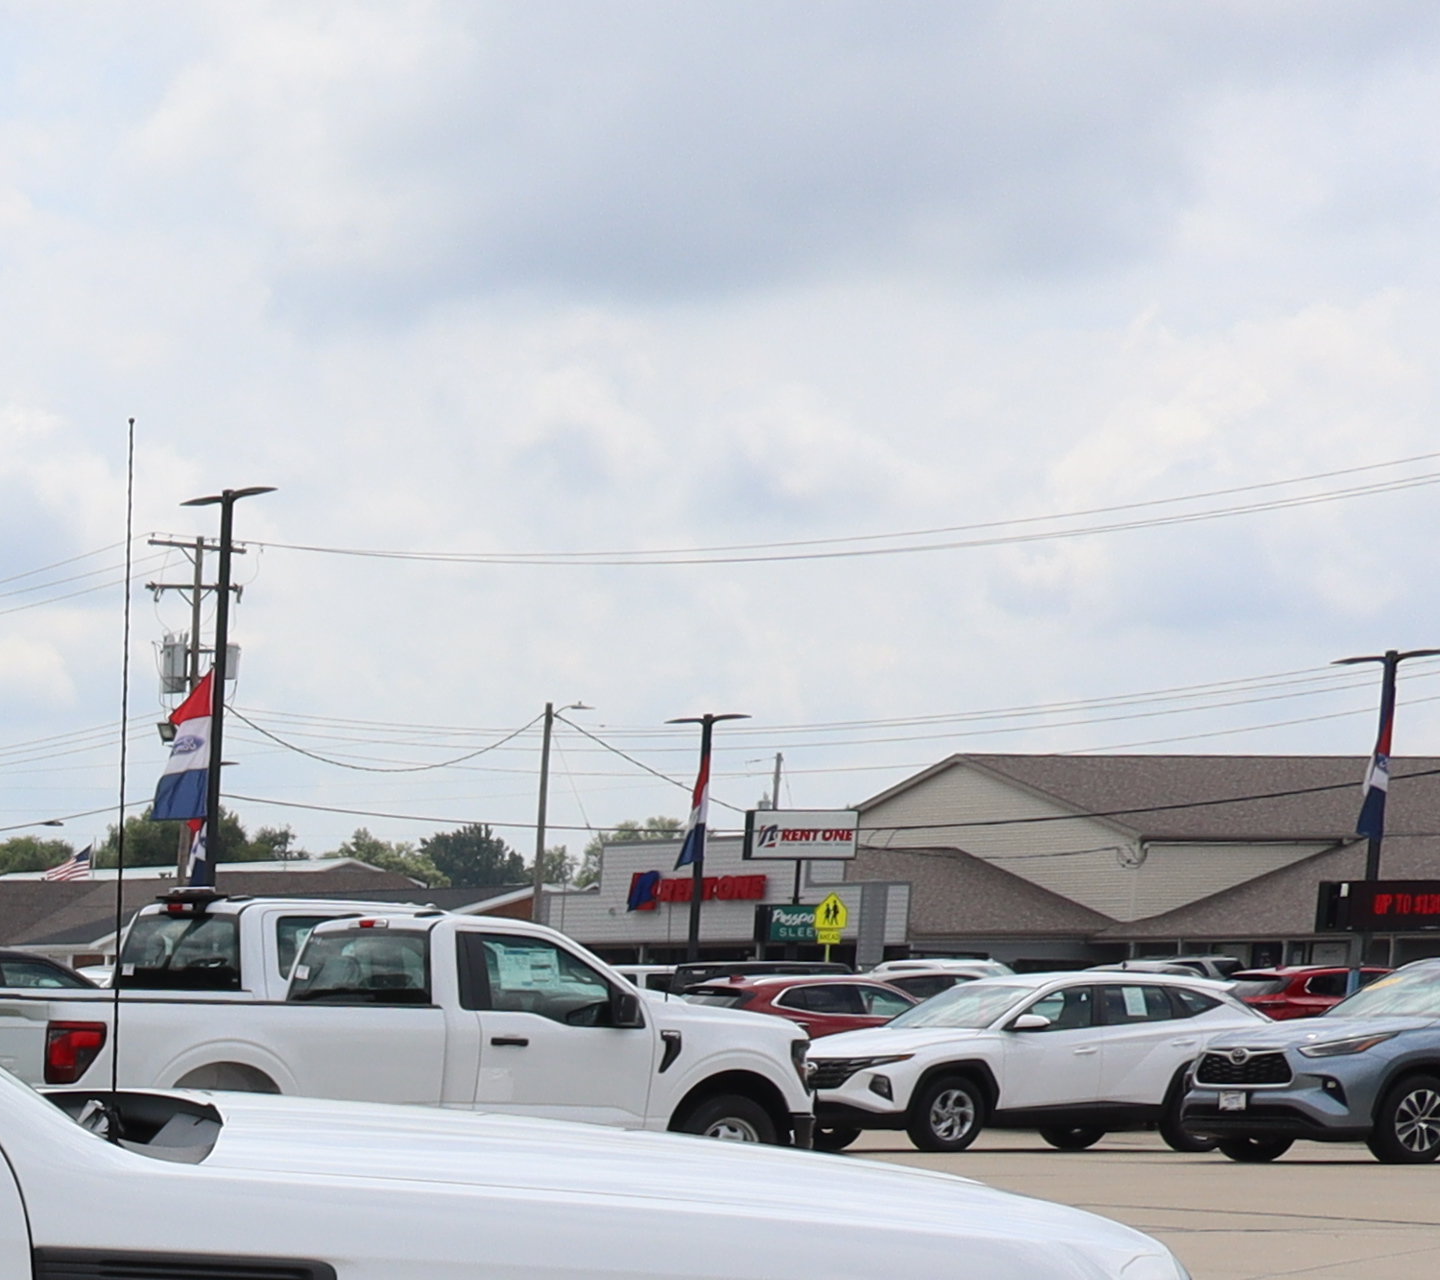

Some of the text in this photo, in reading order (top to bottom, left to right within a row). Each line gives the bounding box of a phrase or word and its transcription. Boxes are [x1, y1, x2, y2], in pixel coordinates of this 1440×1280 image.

[781, 828, 854, 842] RENT ONE
[772, 908, 816, 926] Passpo
[779, 927, 818, 938] SLEE
